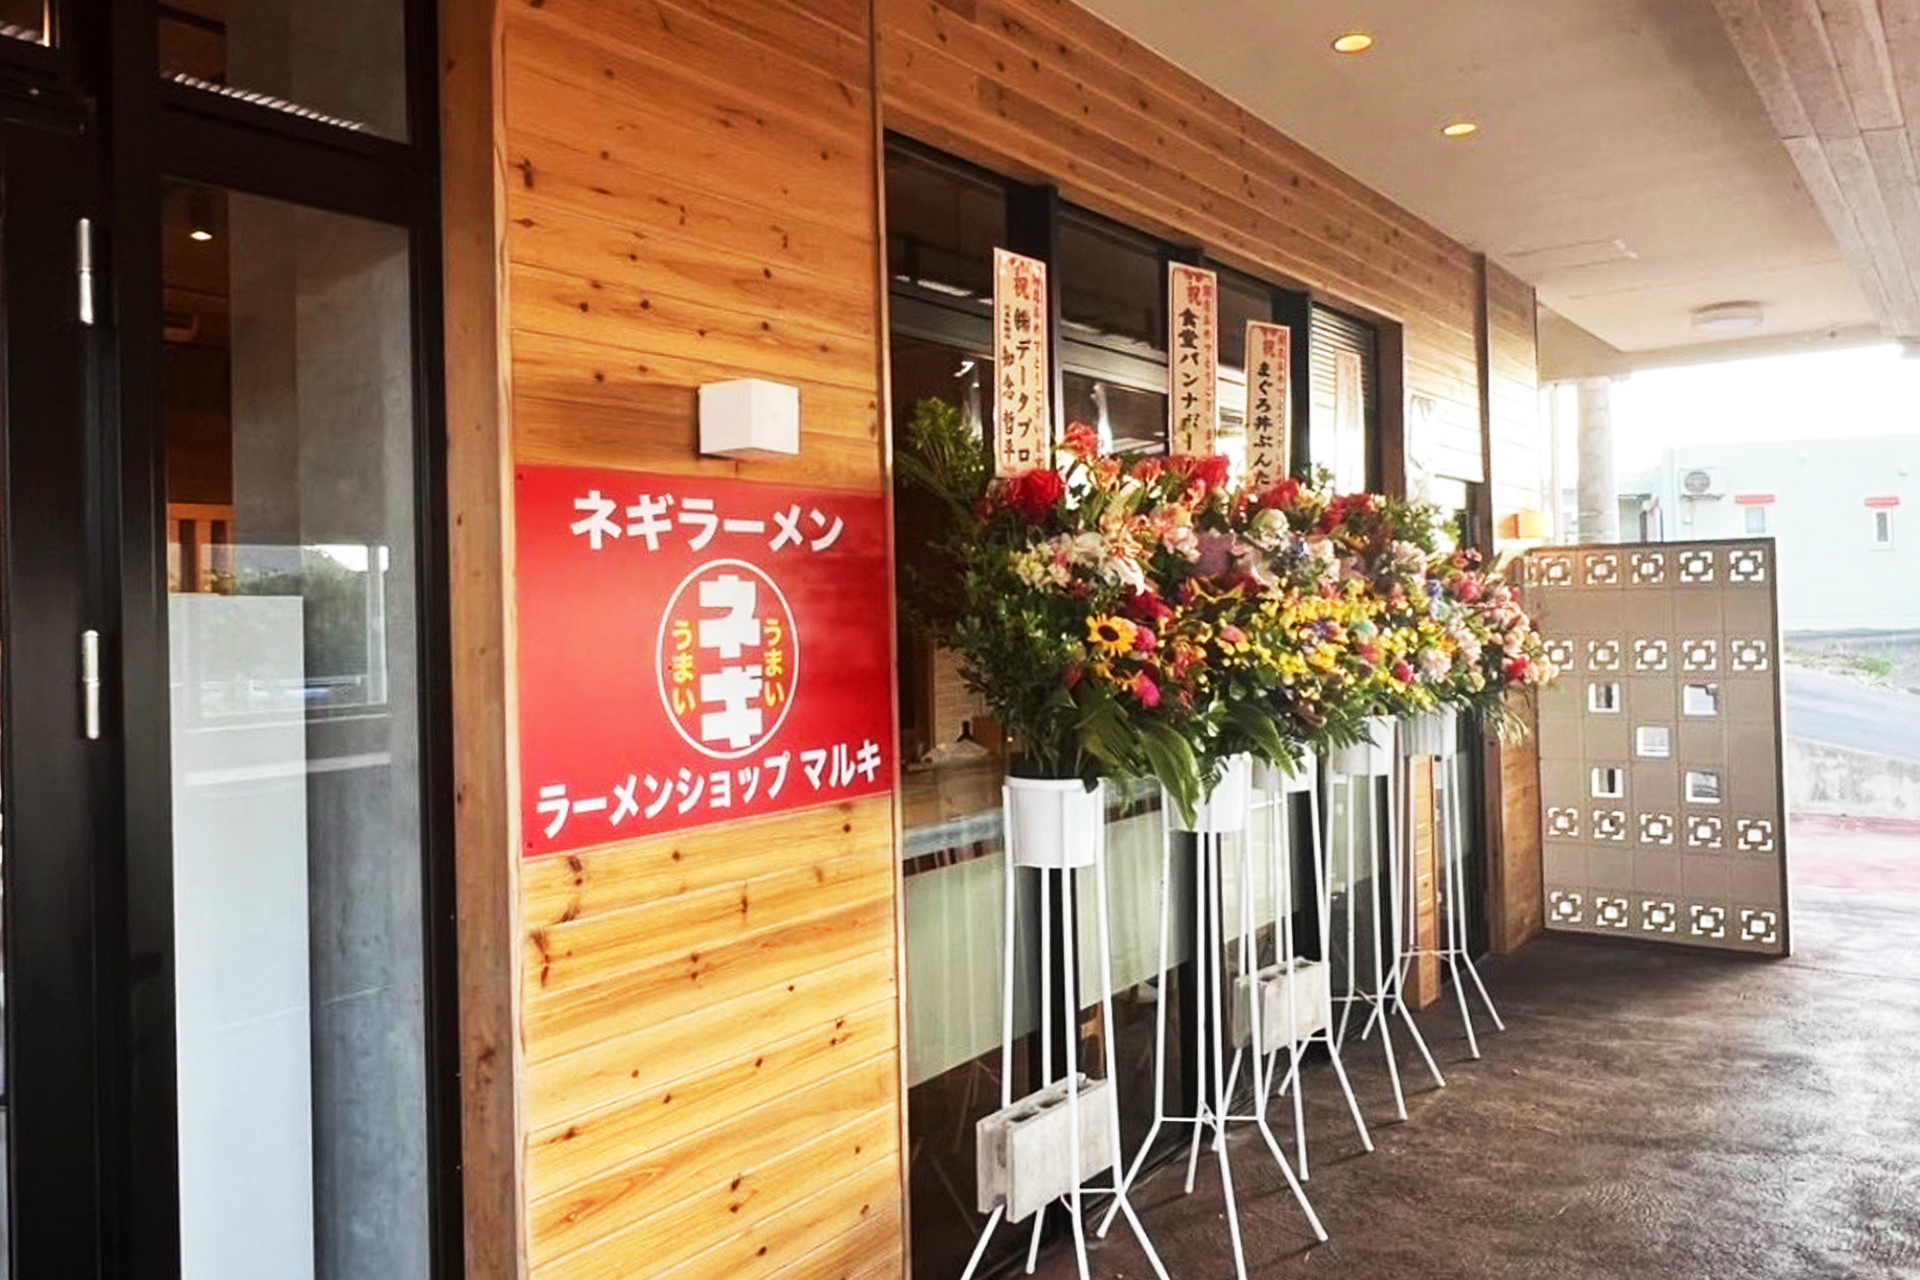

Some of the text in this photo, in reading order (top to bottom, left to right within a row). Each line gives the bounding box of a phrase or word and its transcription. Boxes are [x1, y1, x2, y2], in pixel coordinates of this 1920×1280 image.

[570, 490, 844, 552] ネギラーメン
[672, 620, 696, 716] うまい
[699, 575, 763, 749] ネギ
[763, 618, 785, 708] うまい
[536, 739, 882, 840] ラーメンショップ マルキ
